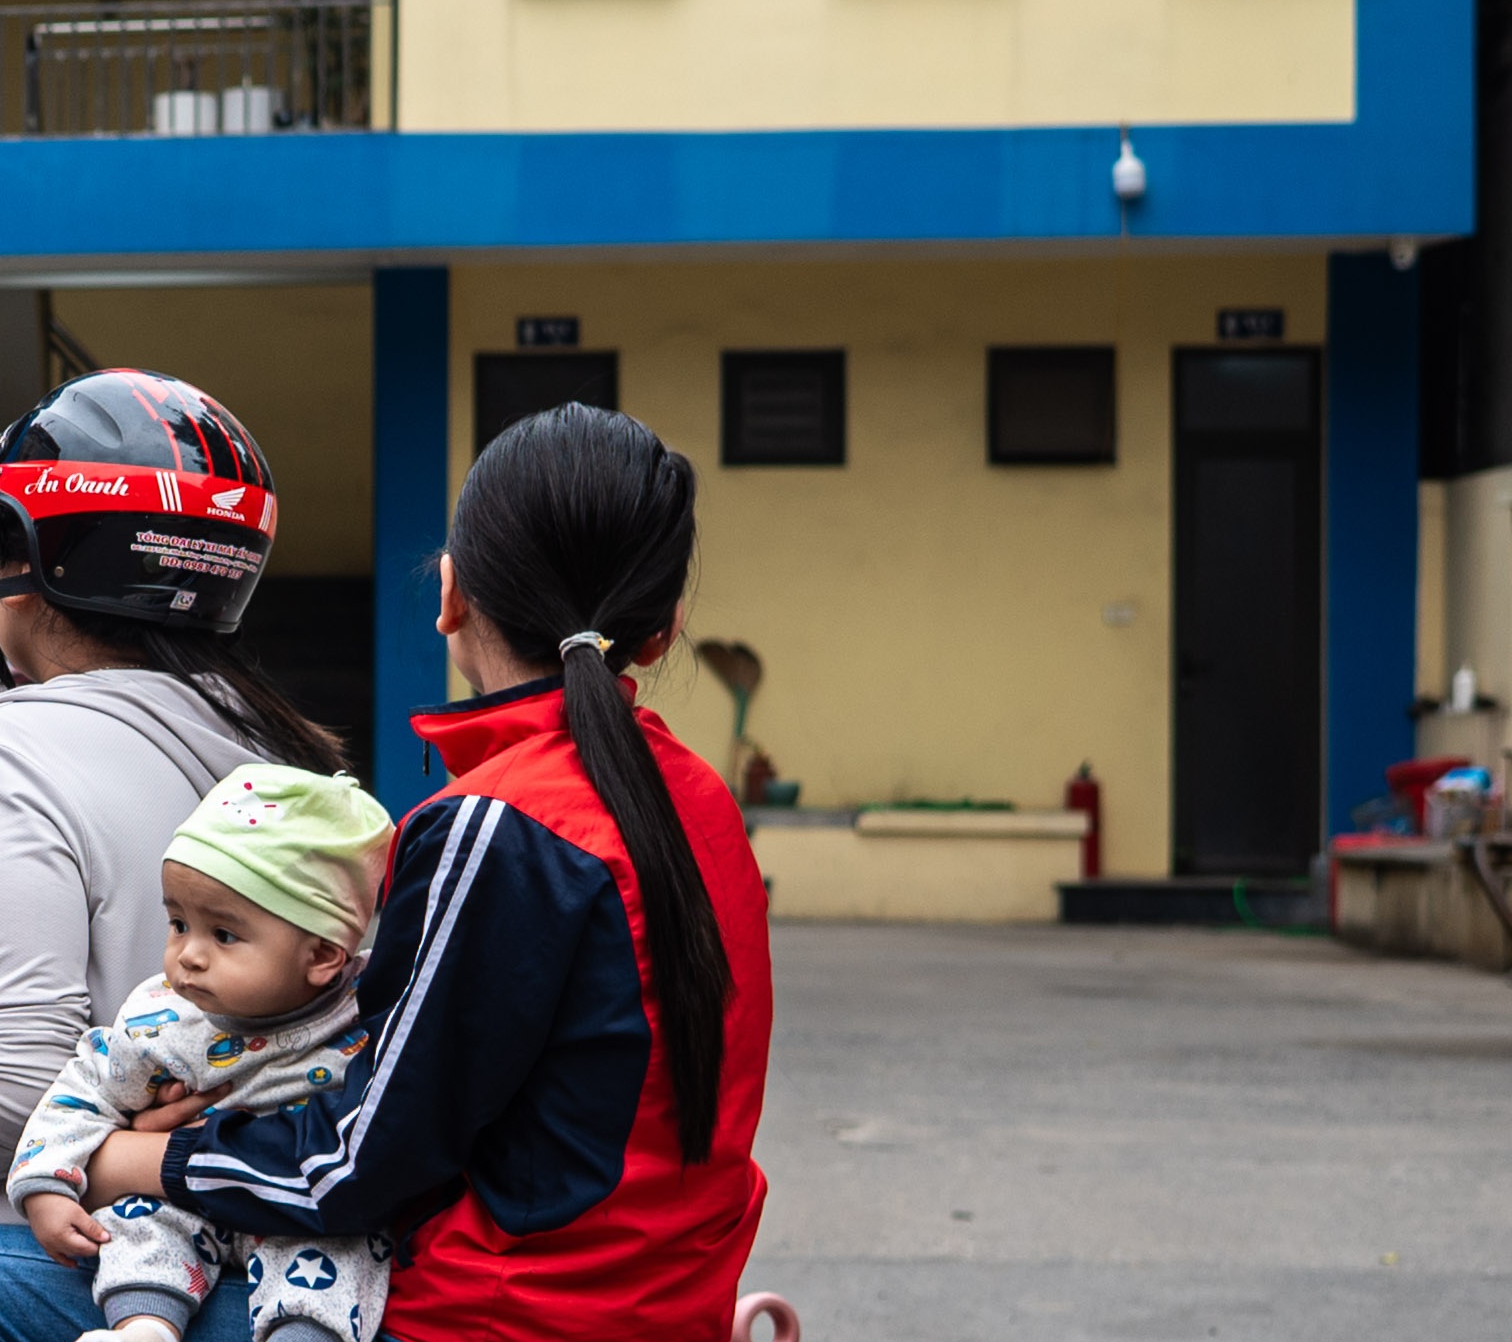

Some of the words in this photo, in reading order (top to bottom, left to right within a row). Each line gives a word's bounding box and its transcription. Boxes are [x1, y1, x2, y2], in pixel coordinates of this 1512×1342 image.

[65, 472, 130, 497] Oanh
[207, 506, 246, 522] HONDA
[135, 530, 170, 546] TỔNG
